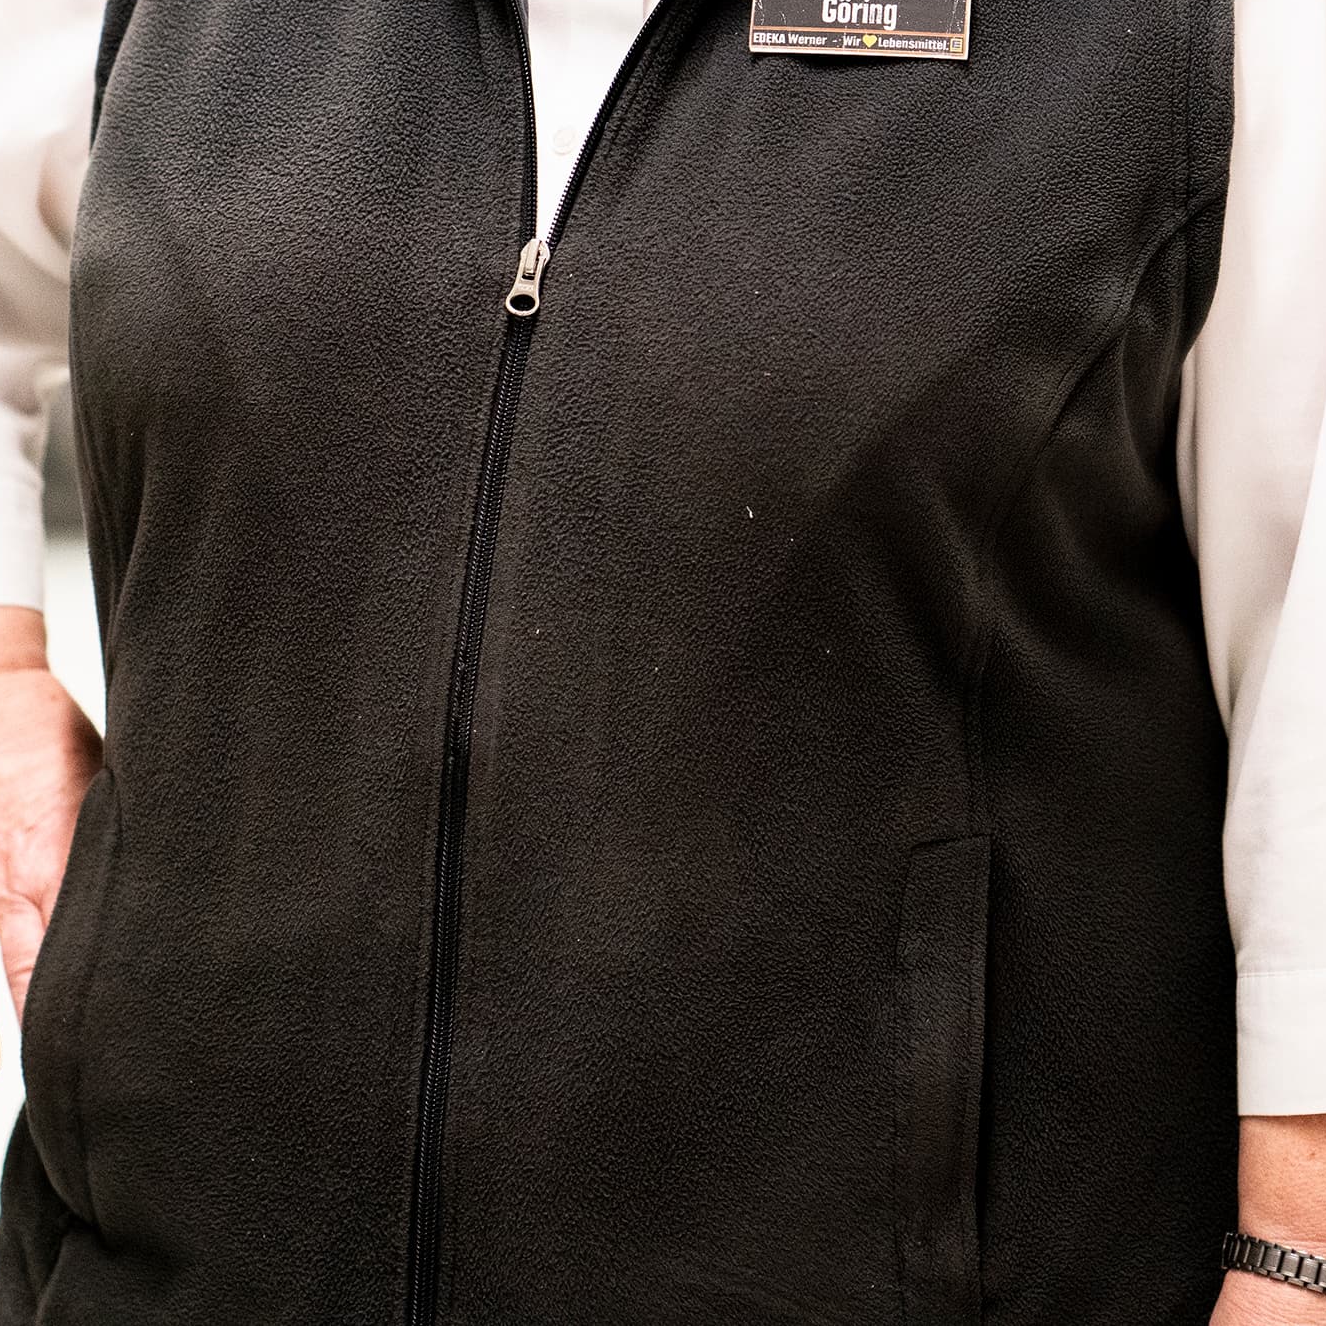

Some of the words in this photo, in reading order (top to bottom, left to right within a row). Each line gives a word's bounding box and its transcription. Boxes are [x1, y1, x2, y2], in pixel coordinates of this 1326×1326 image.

[753, 32, 786, 44] EDEKA
[787, 33, 828, 45] Werner
[842, 35, 862, 46] Wir
